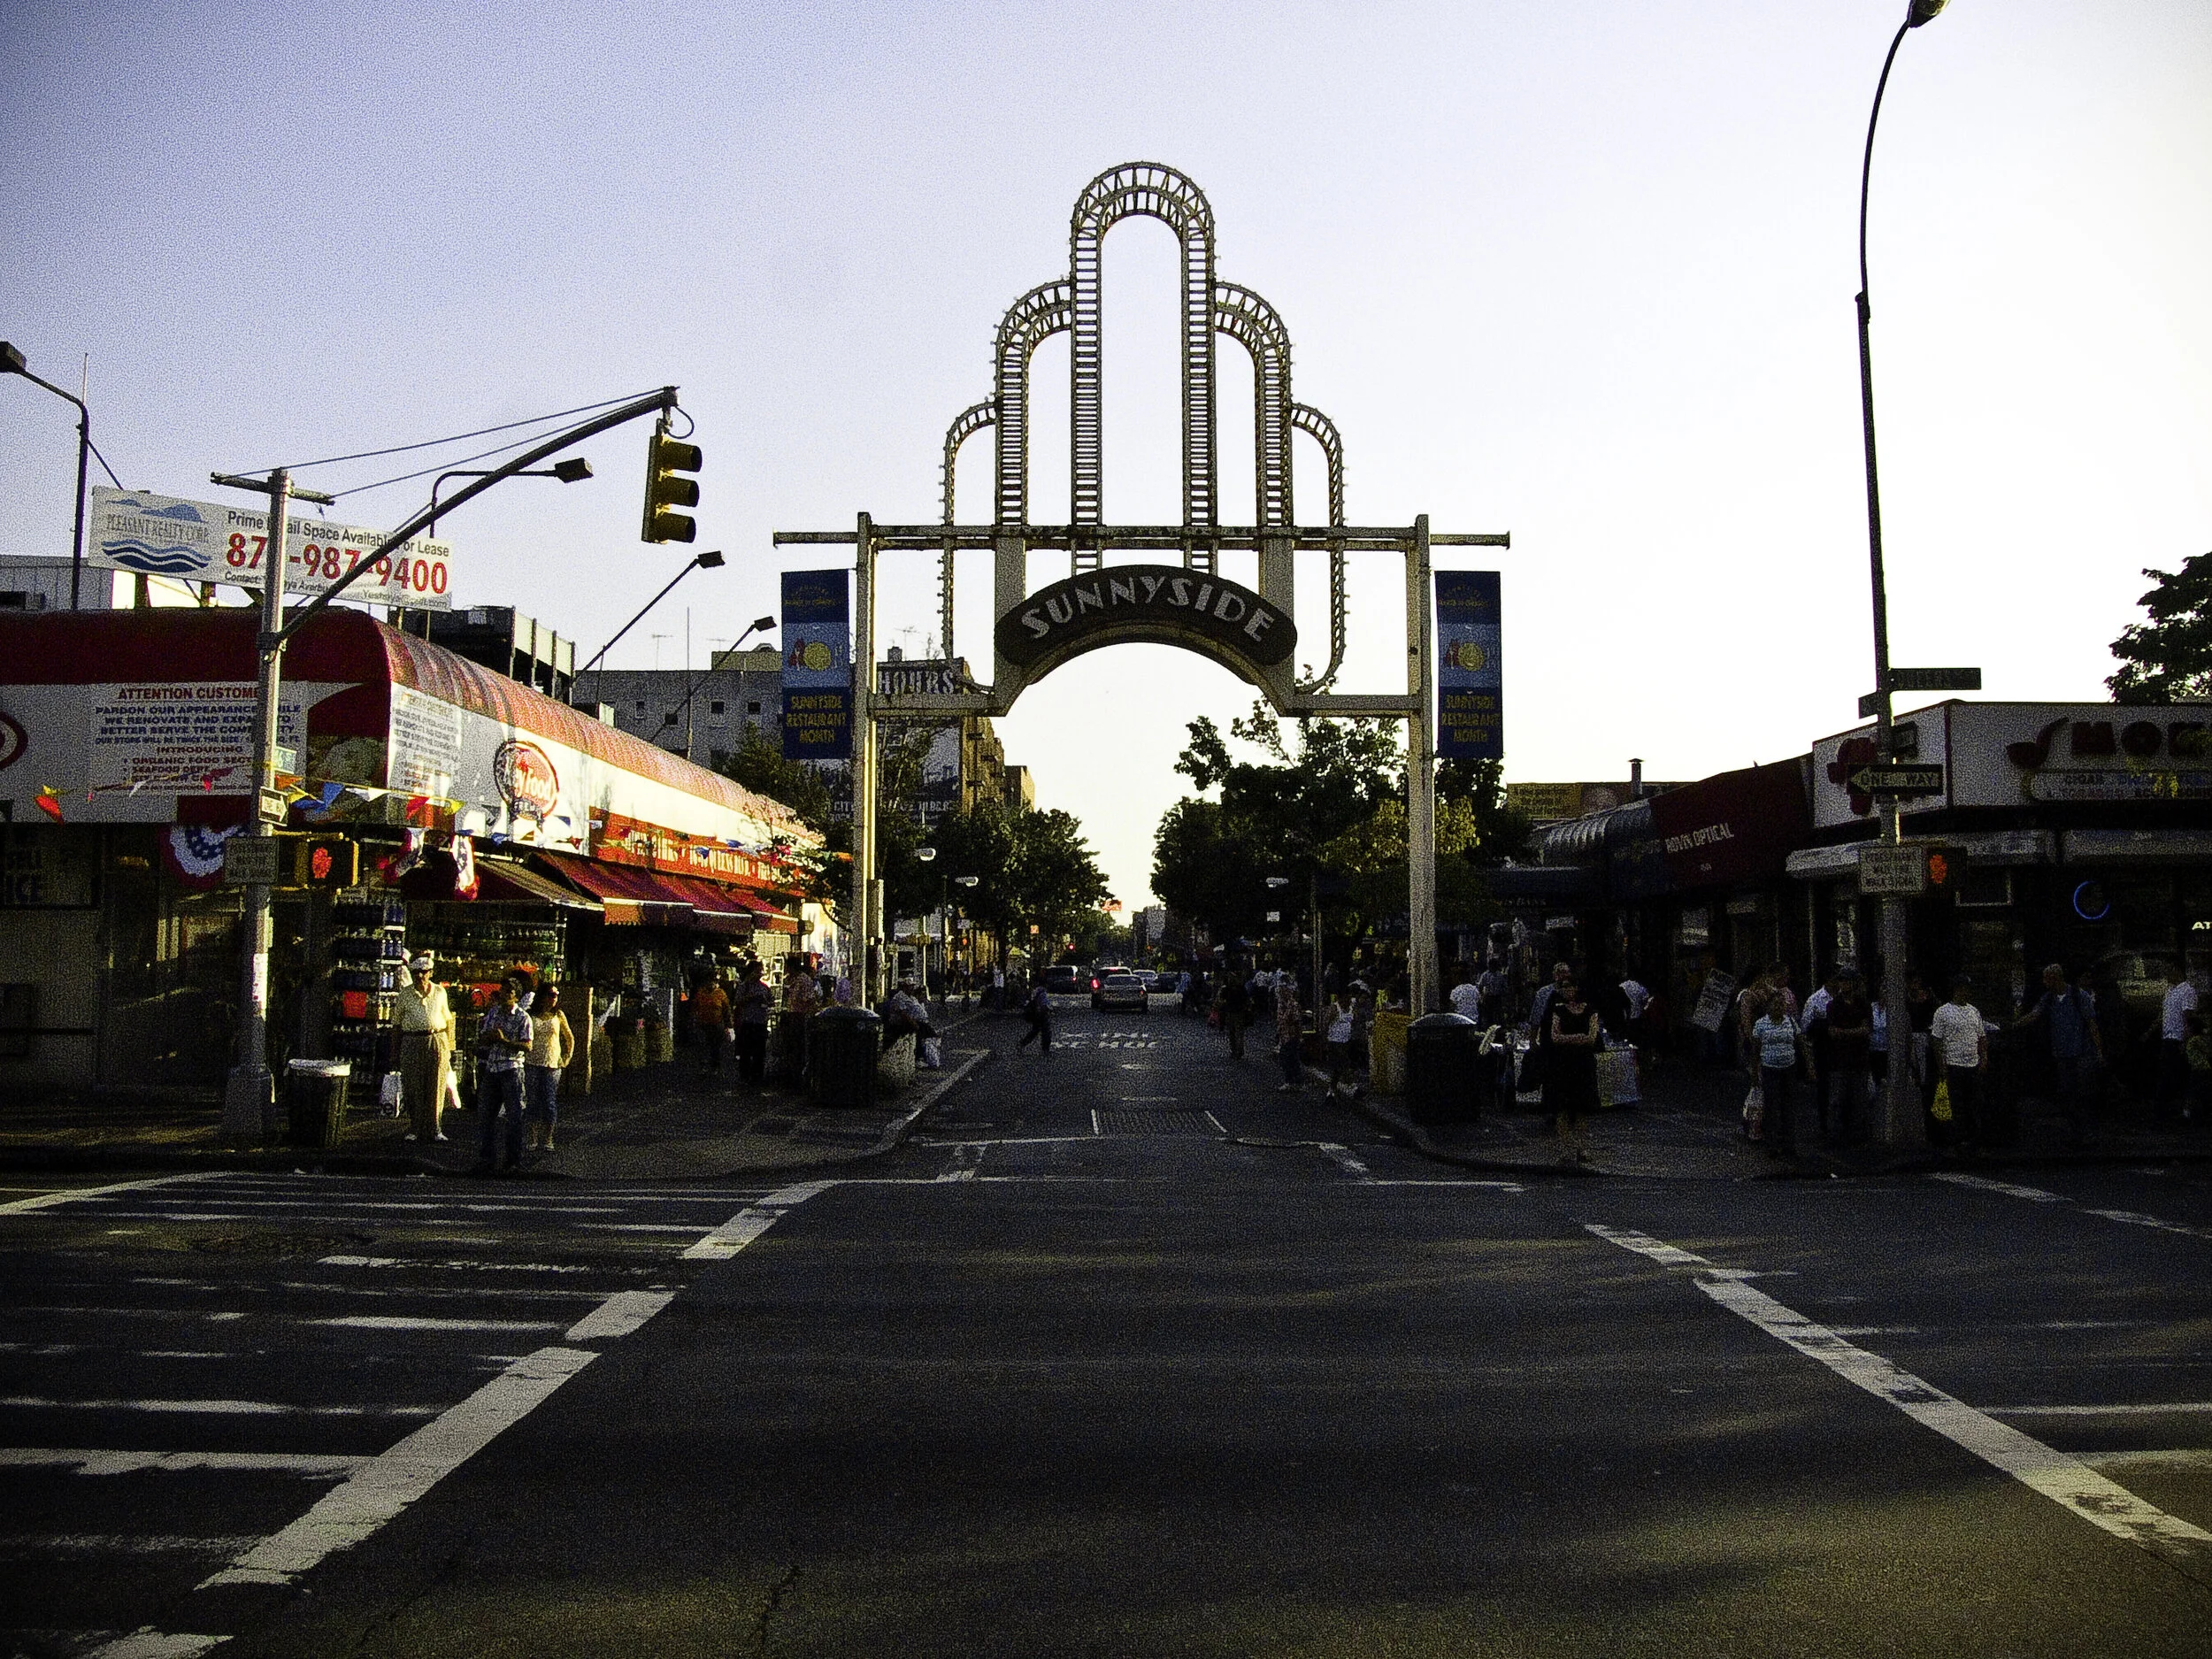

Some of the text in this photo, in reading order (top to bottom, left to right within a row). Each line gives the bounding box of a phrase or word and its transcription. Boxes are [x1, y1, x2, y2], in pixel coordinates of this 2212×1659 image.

[227, 511, 265, 529] Prime
[303, 522, 340, 541] Space
[342, 529, 392, 548] Availabl
[418, 541, 449, 557] Lease
[226, 533, 449, 595] 87-987-9400
[1021, 575, 1275, 642] SUNNYSIDE
[878, 669, 956, 695] HOURS
[118, 687, 257, 699] ATTENTION CUSTOME
[791, 695, 842, 710] SUNNYSIDE
[1446, 695, 1495, 710] SUNNYSIDE
[223, 715, 255, 724] EXPA
[787, 712, 847, 727] RESTAURANT
[1441, 712, 1500, 726] RESTAURANT
[798, 728, 836, 743] MONTH
[1453, 728, 1488, 742] MONTH
[1860, 772, 1936, 786] ONE WAY
[1692, 822, 1735, 847] OPTICAL
